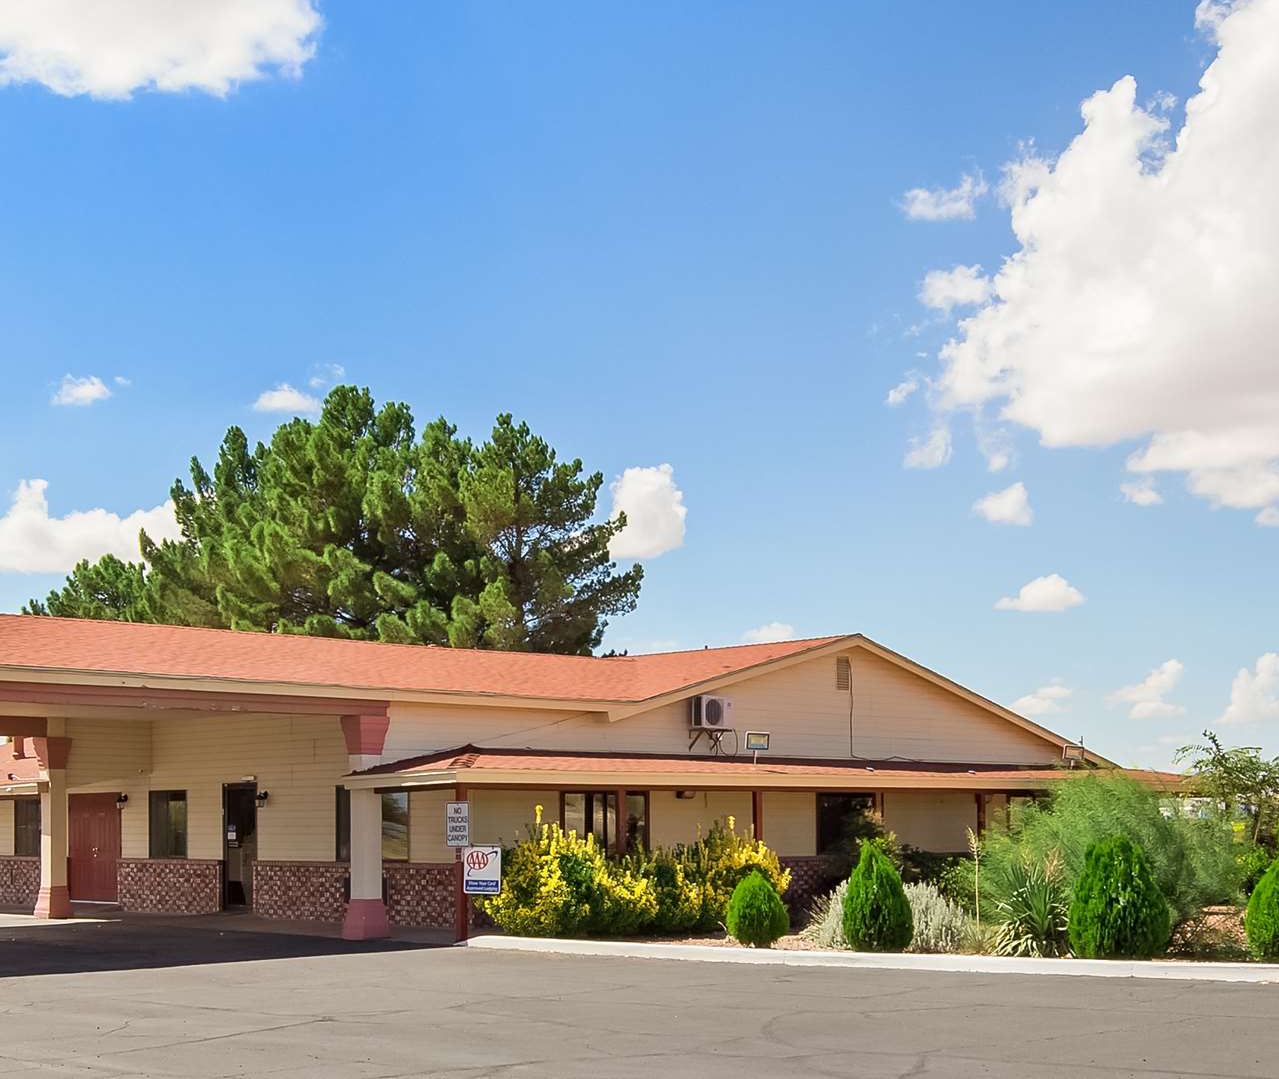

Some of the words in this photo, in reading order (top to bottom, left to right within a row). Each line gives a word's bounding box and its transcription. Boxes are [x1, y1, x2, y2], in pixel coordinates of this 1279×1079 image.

[453, 807, 462, 815] NO
[448, 816, 467, 824] TRUCKS
[449, 825, 467, 833] UNDER
[468, 851, 488, 870] AAA
